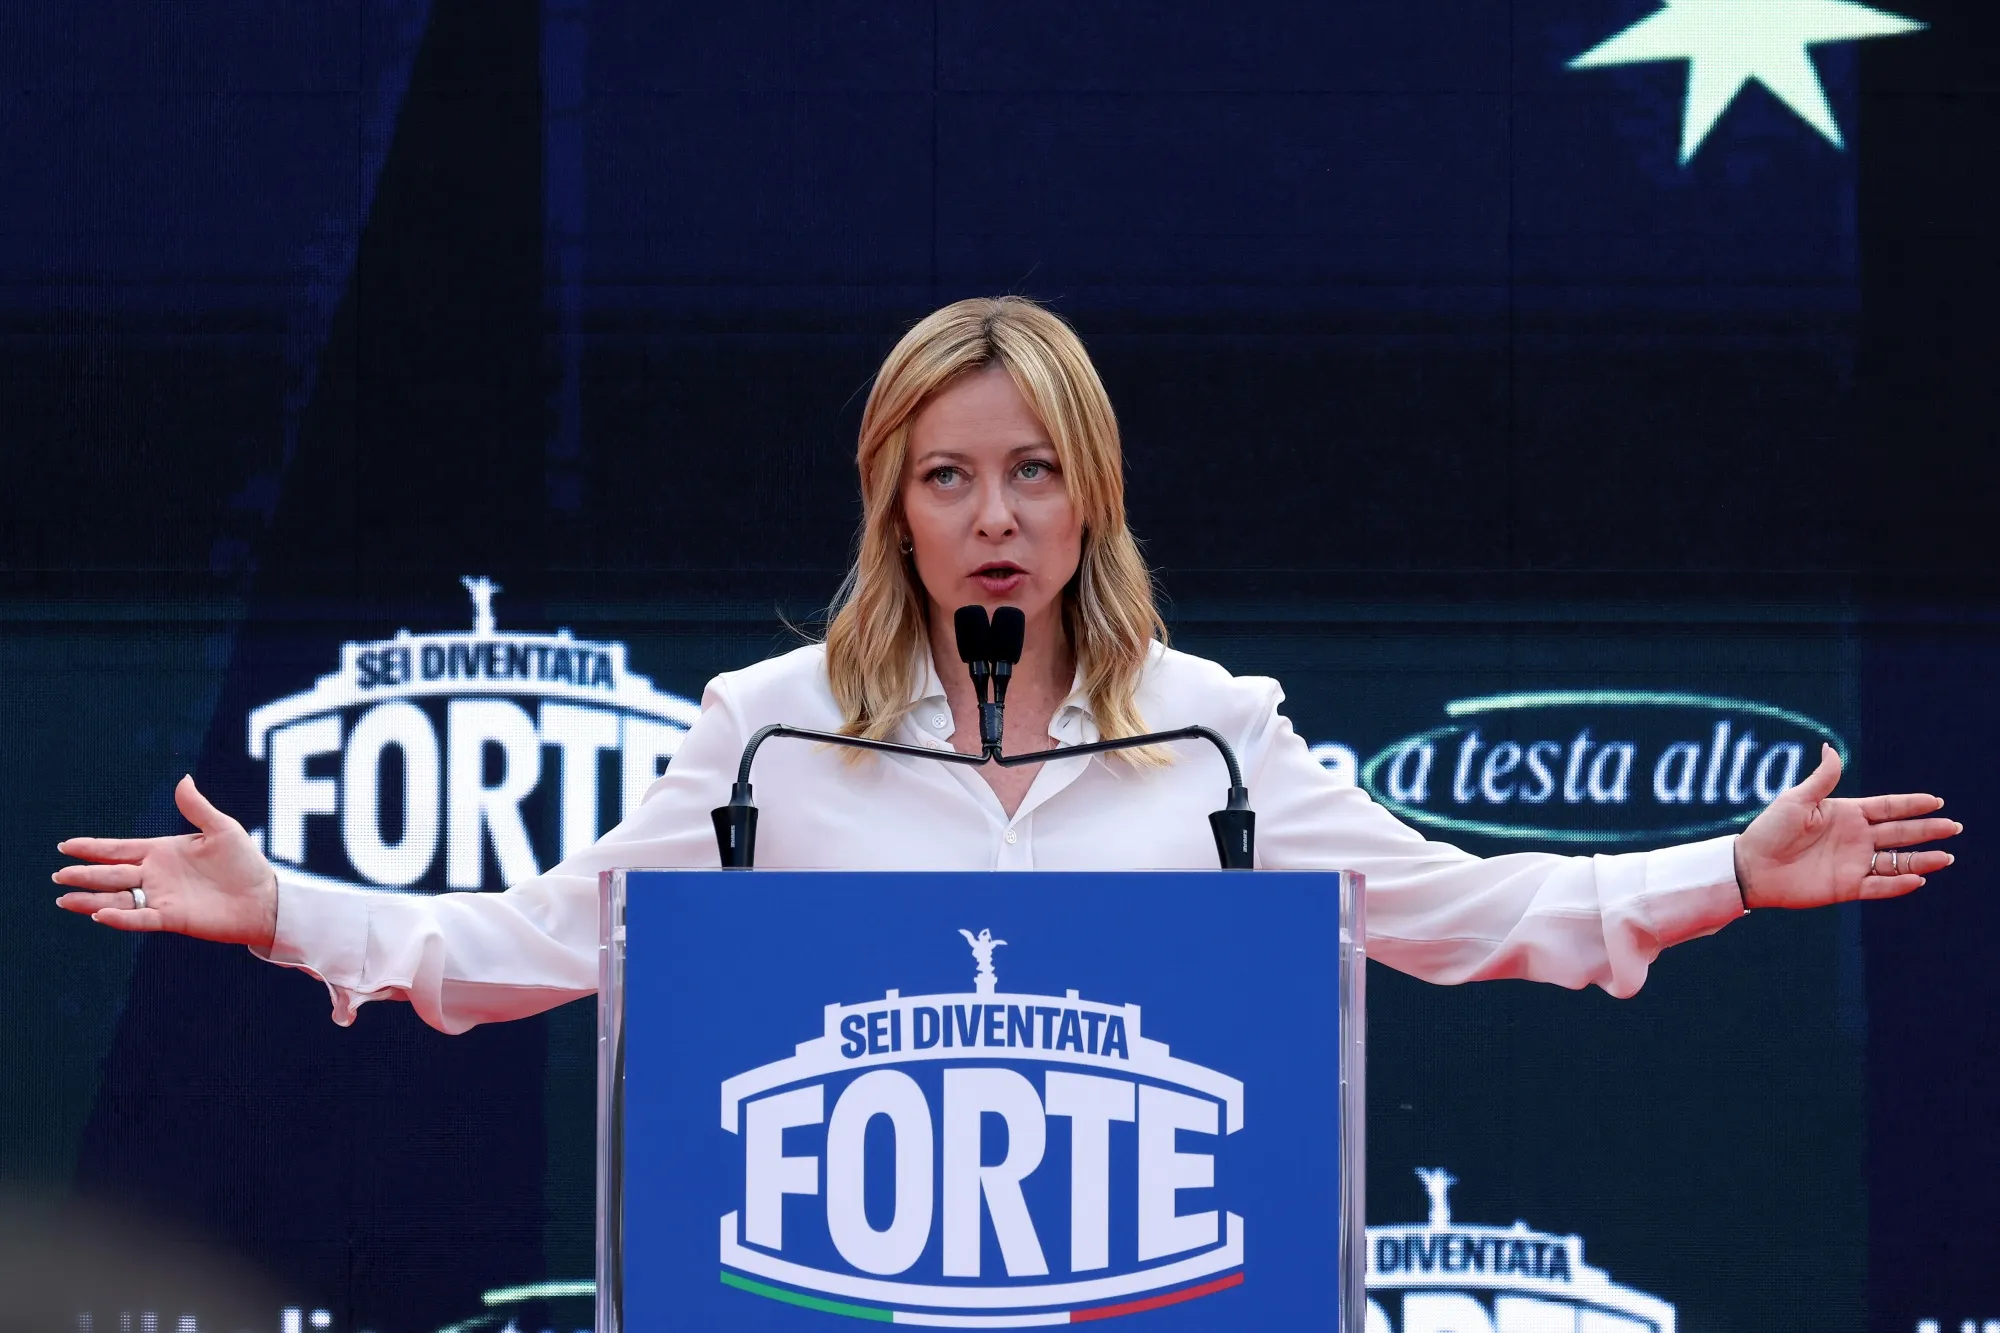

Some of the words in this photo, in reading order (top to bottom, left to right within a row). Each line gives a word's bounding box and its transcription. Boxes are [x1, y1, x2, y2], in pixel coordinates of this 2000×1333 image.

[356, 647, 411, 690] SEI
[421, 641, 615, 691] DIVENTATA
[1387, 742, 1435, 803] a
[1453, 730, 1636, 803] testa
[1653, 720, 1803, 803] alta
[839, 1009, 901, 1059] SEI
[913, 1004, 1130, 1060] DIVENTATA
[745, 1067, 1219, 1277] FORTE
[1376, 1235, 1572, 1283] DIVENTATA
